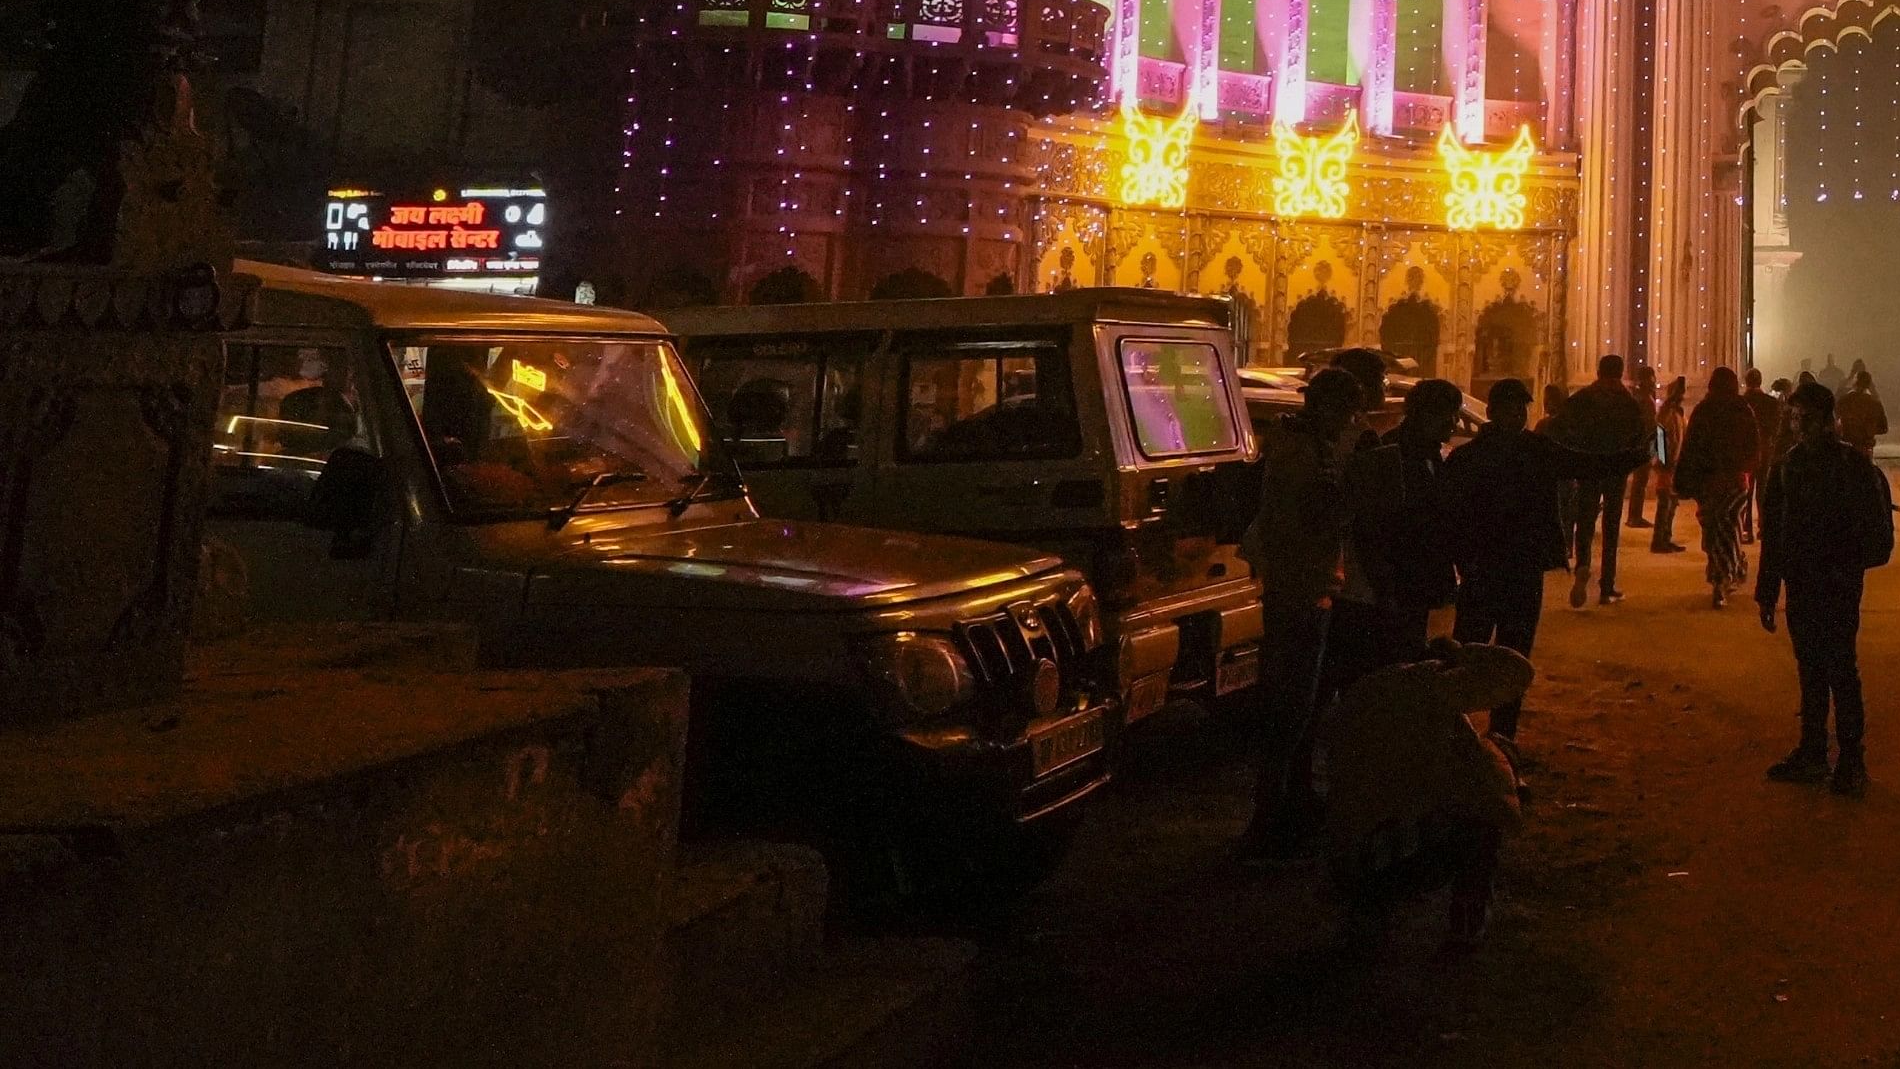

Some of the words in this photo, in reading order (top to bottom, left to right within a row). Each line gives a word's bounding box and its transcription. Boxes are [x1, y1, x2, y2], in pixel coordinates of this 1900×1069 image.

[391, 206, 427, 225] जय
[372, 226, 448, 250] मोबाइल
[450, 226, 500, 249] सेन्टर
